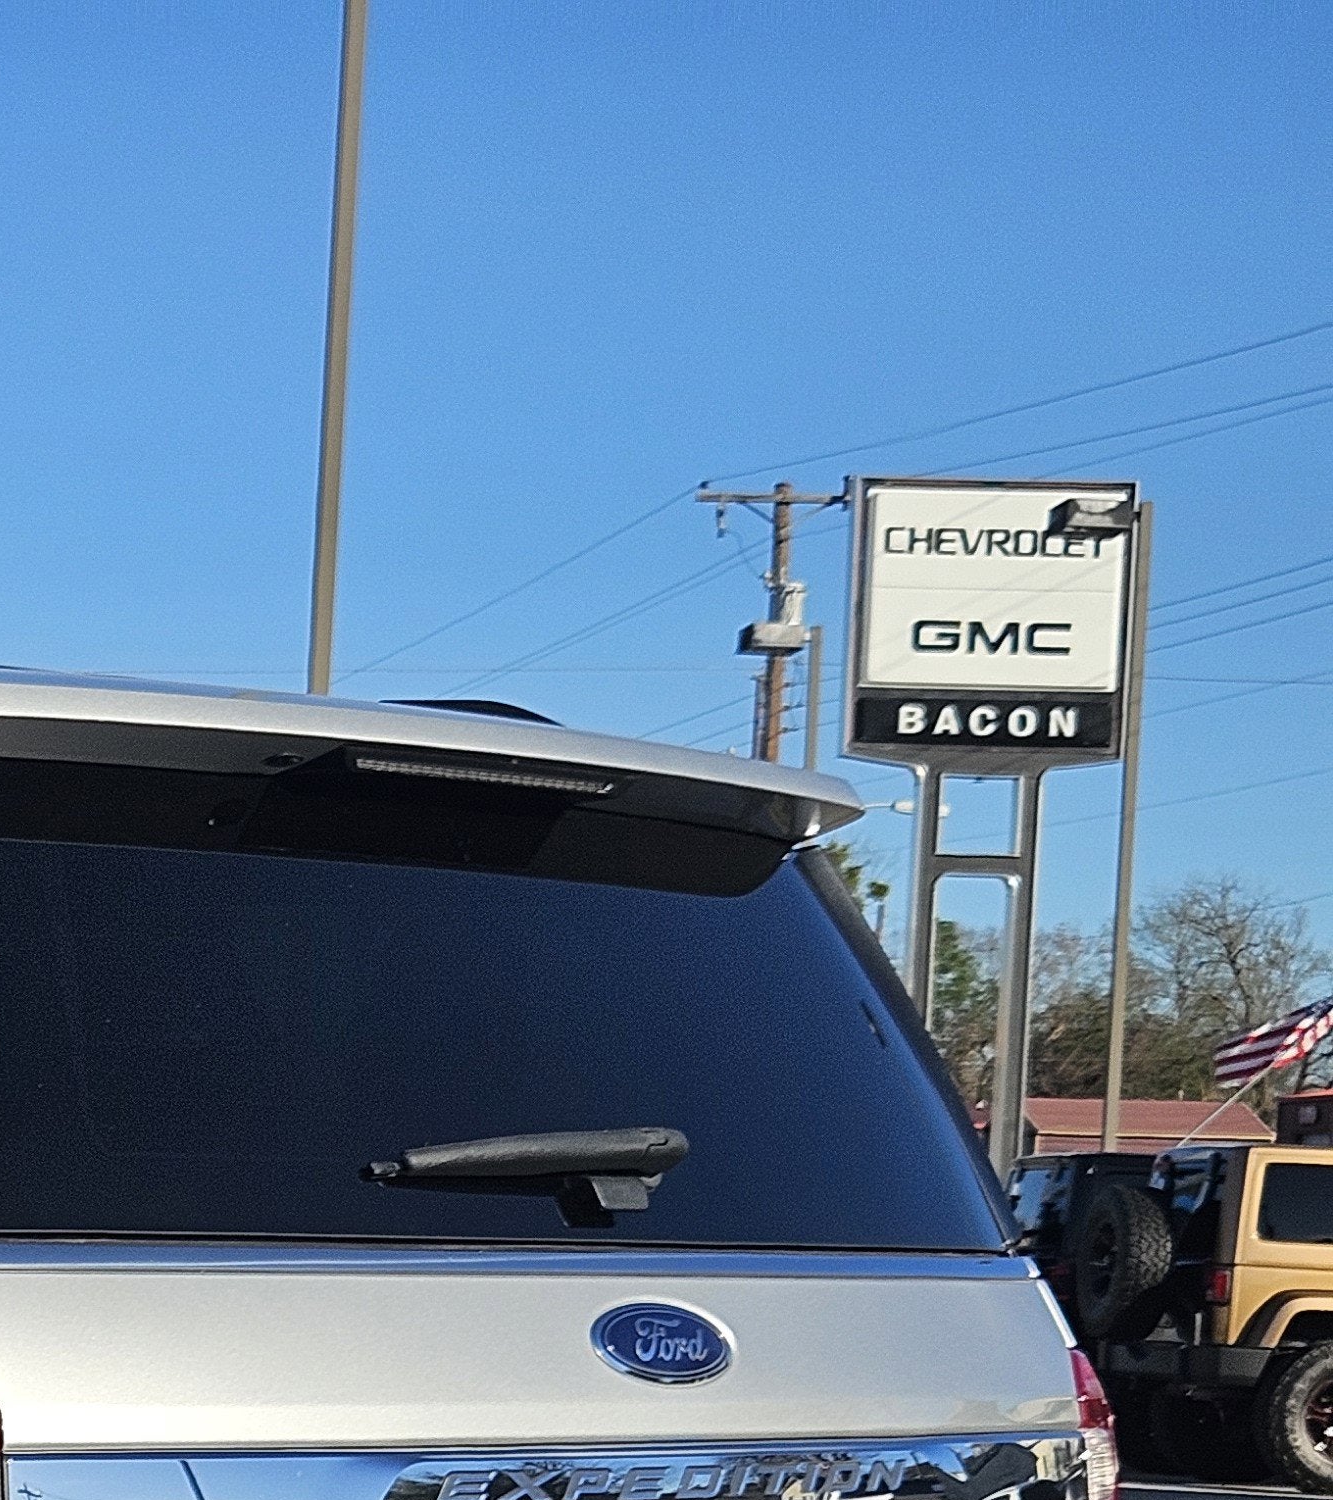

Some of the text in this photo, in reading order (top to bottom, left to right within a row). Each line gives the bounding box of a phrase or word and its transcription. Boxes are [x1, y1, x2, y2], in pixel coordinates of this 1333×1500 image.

[884, 526, 1103, 558] CHEVROLET
[912, 619, 1072, 655] GMC
[897, 702, 1080, 738] BACON
[634, 1317, 709, 1362] Ford
